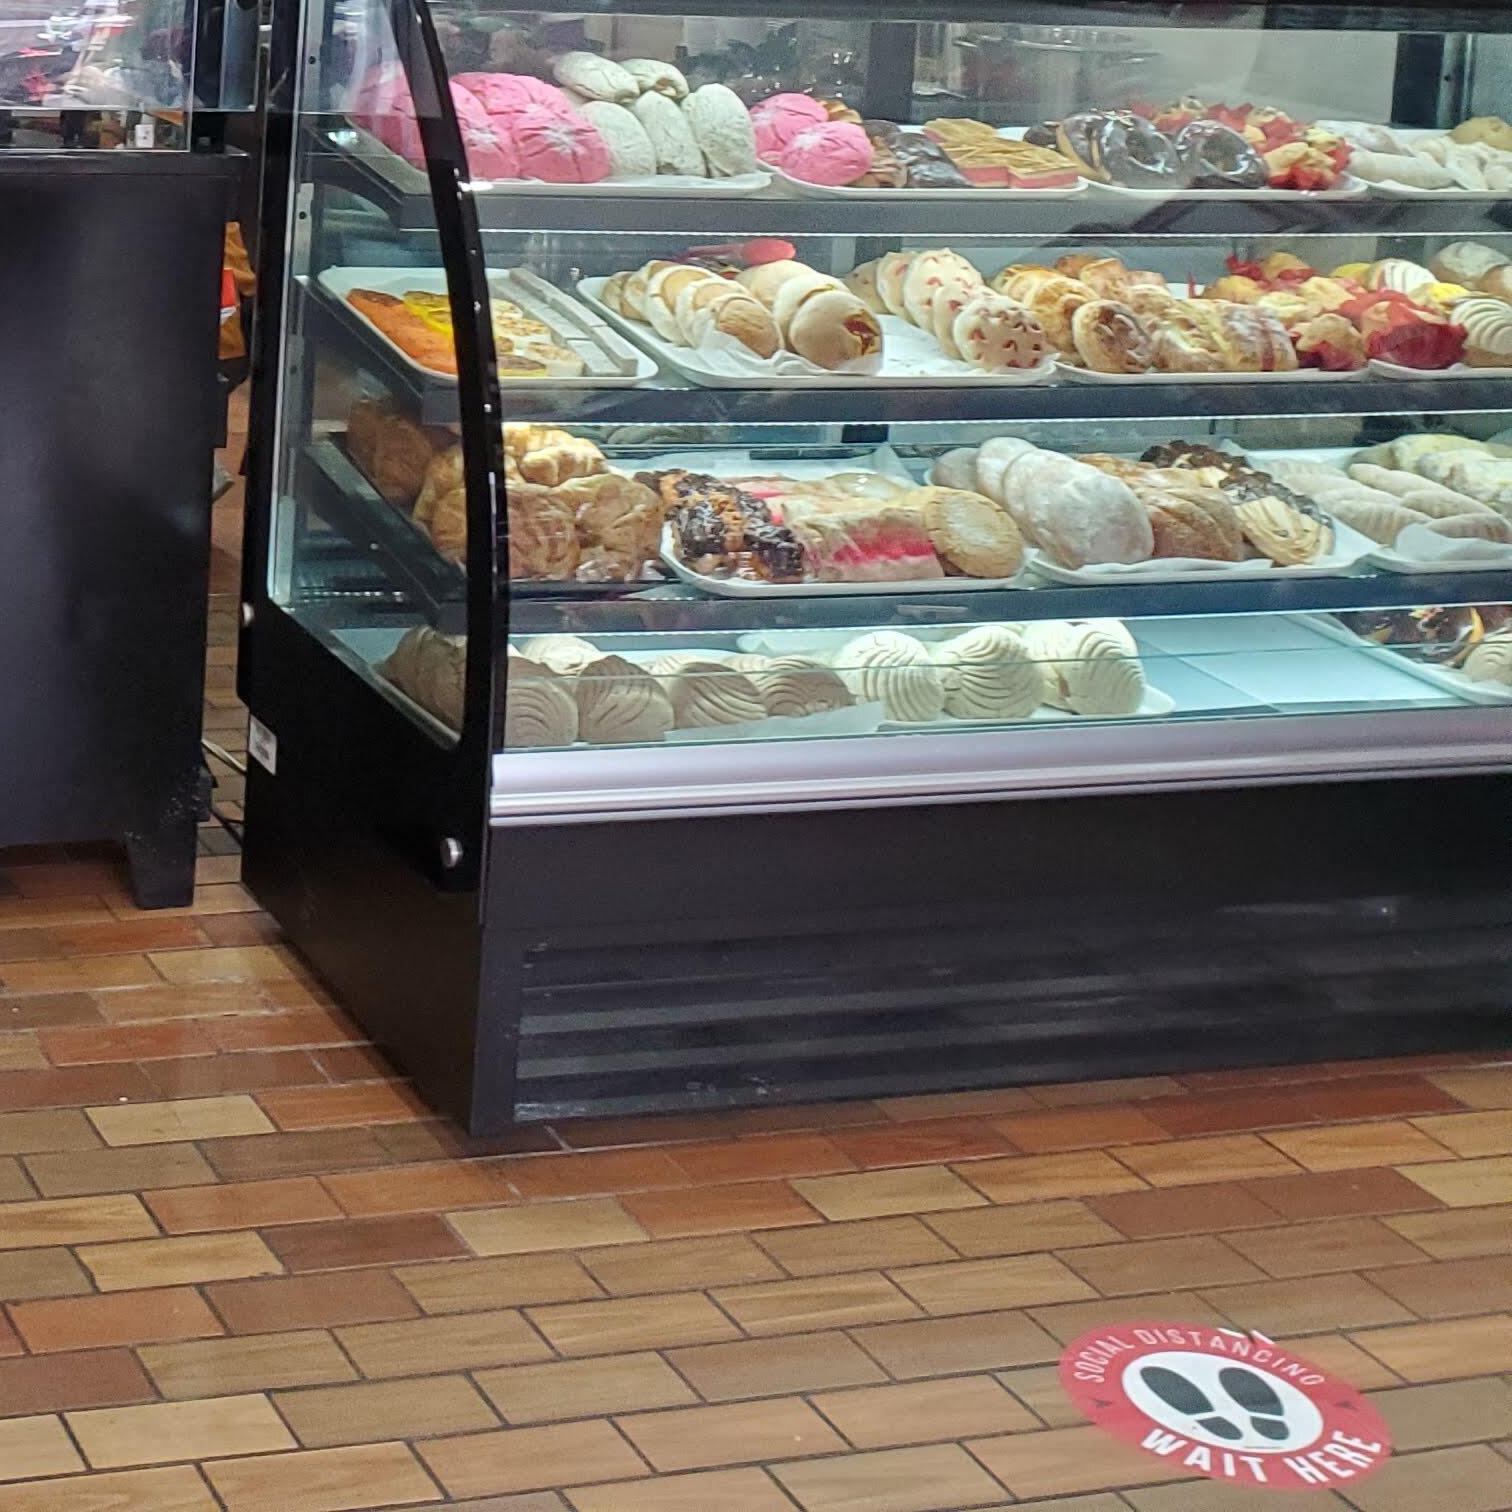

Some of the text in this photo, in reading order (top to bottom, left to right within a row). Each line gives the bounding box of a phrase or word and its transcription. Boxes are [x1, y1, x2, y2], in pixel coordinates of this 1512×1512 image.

[1073, 1328, 1326, 1386] SOCIAL DISTANCING
[1141, 1429, 1383, 1485] WAIT HERE
